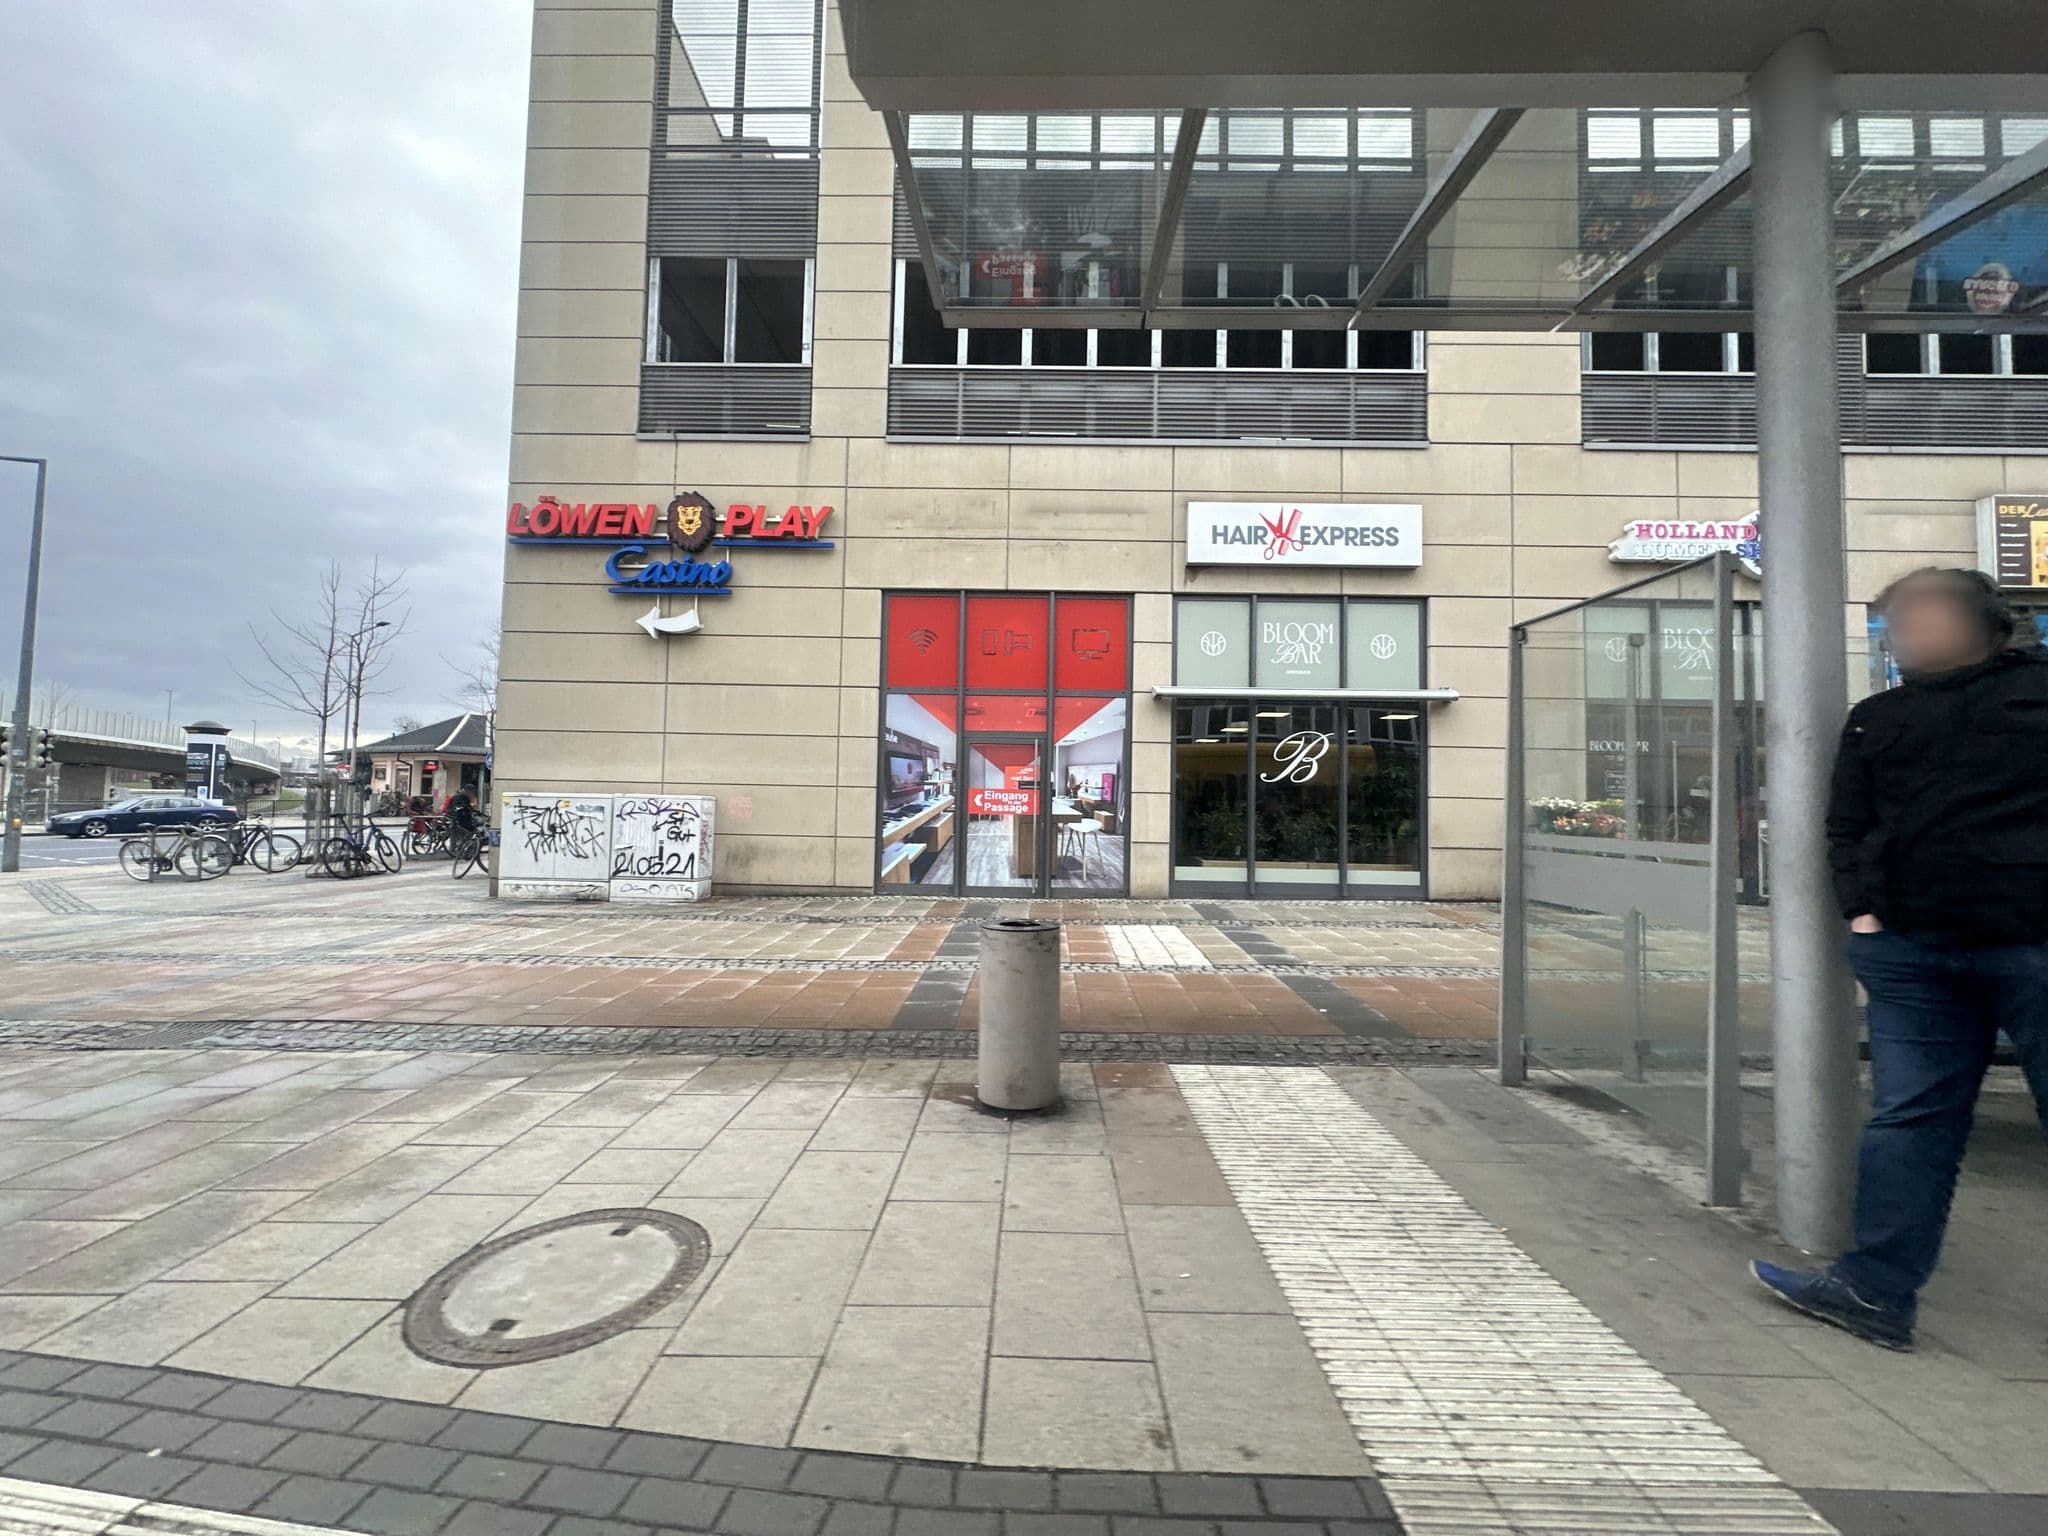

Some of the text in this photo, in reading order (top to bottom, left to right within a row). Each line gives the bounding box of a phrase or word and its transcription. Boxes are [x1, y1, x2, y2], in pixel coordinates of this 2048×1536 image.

[507, 495, 833, 537] LÖWEN PLAY
[1999, 504, 2027, 515] DER
[1211, 525, 1400, 546] HAIR EXPRESS
[1635, 523, 1757, 541] HOLLAND
[605, 546, 733, 585] Casino
[1263, 622, 1334, 644] BLOOM
[1270, 642, 1322, 664] BAR
[1260, 730, 1335, 783] B
[984, 790, 1029, 803] Eingang
[984, 802, 1029, 815] Passage
